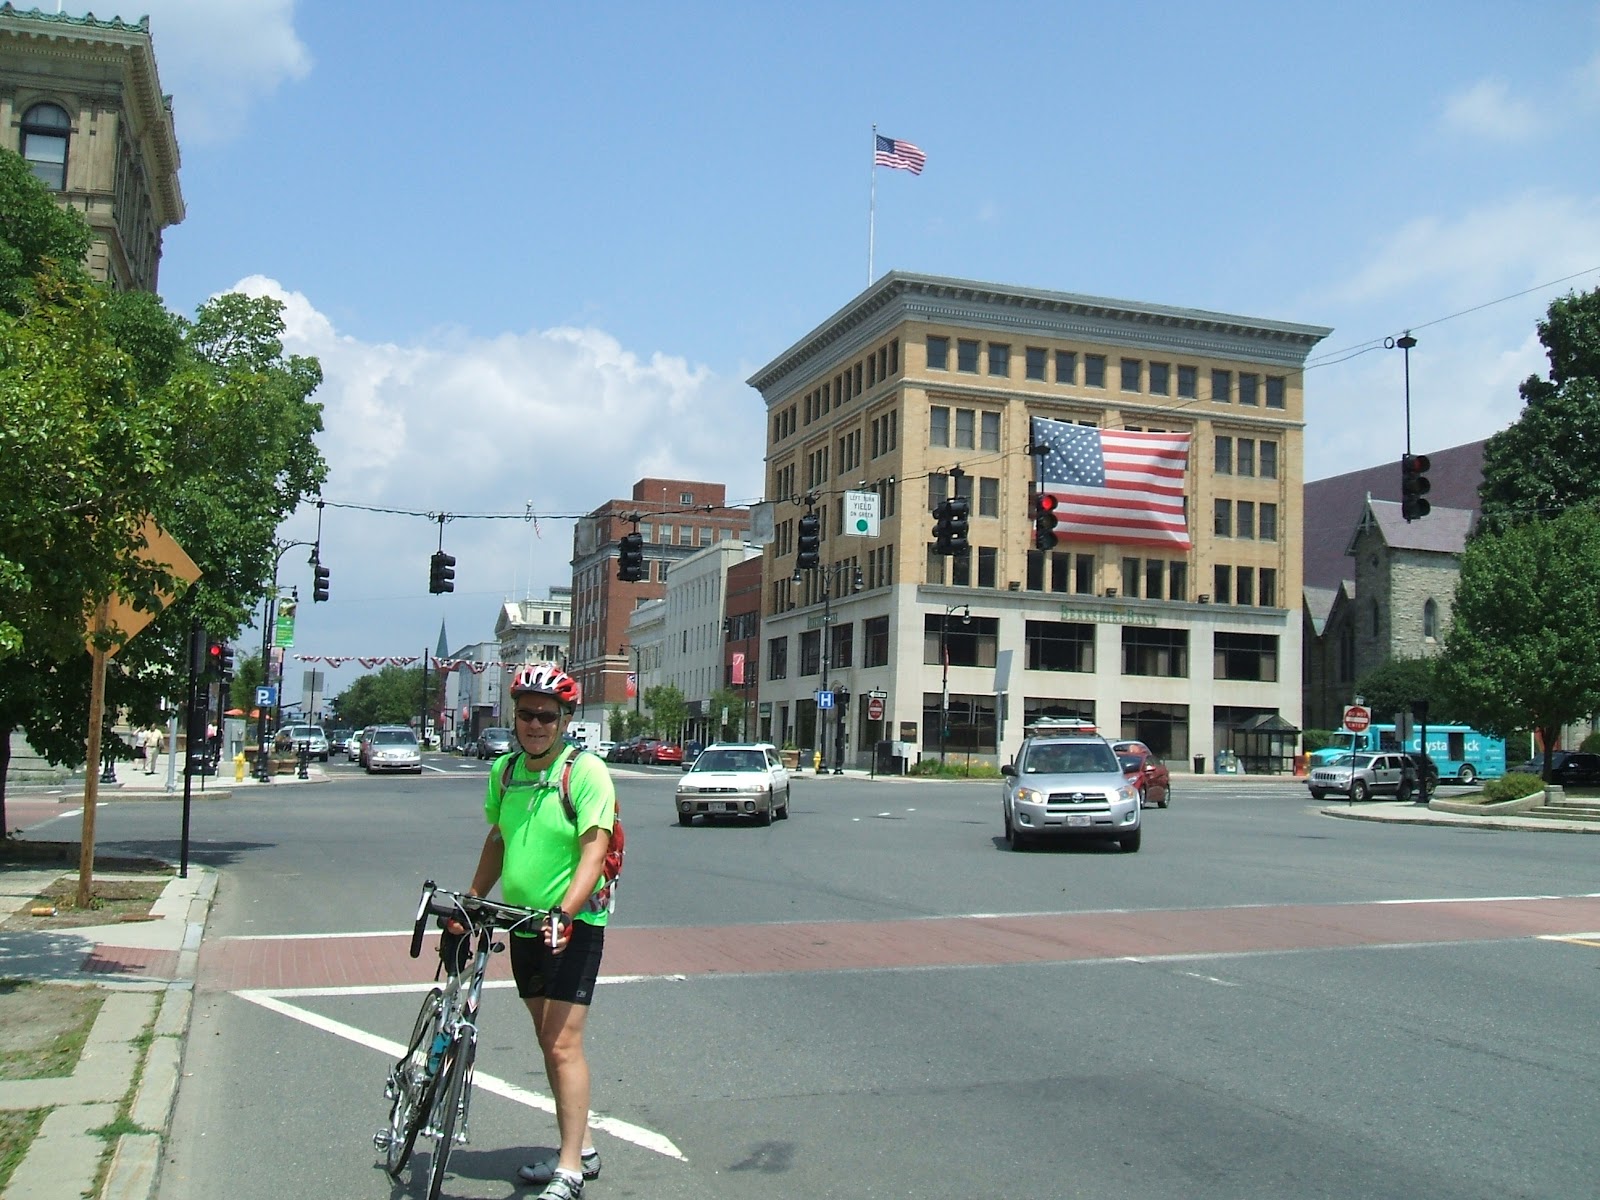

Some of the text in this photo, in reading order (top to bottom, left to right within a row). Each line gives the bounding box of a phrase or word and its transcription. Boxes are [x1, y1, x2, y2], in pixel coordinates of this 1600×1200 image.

[854, 502, 872, 511] YIELD
[820, 693, 832, 707] H
[1412, 738, 1449, 755] Cysta
